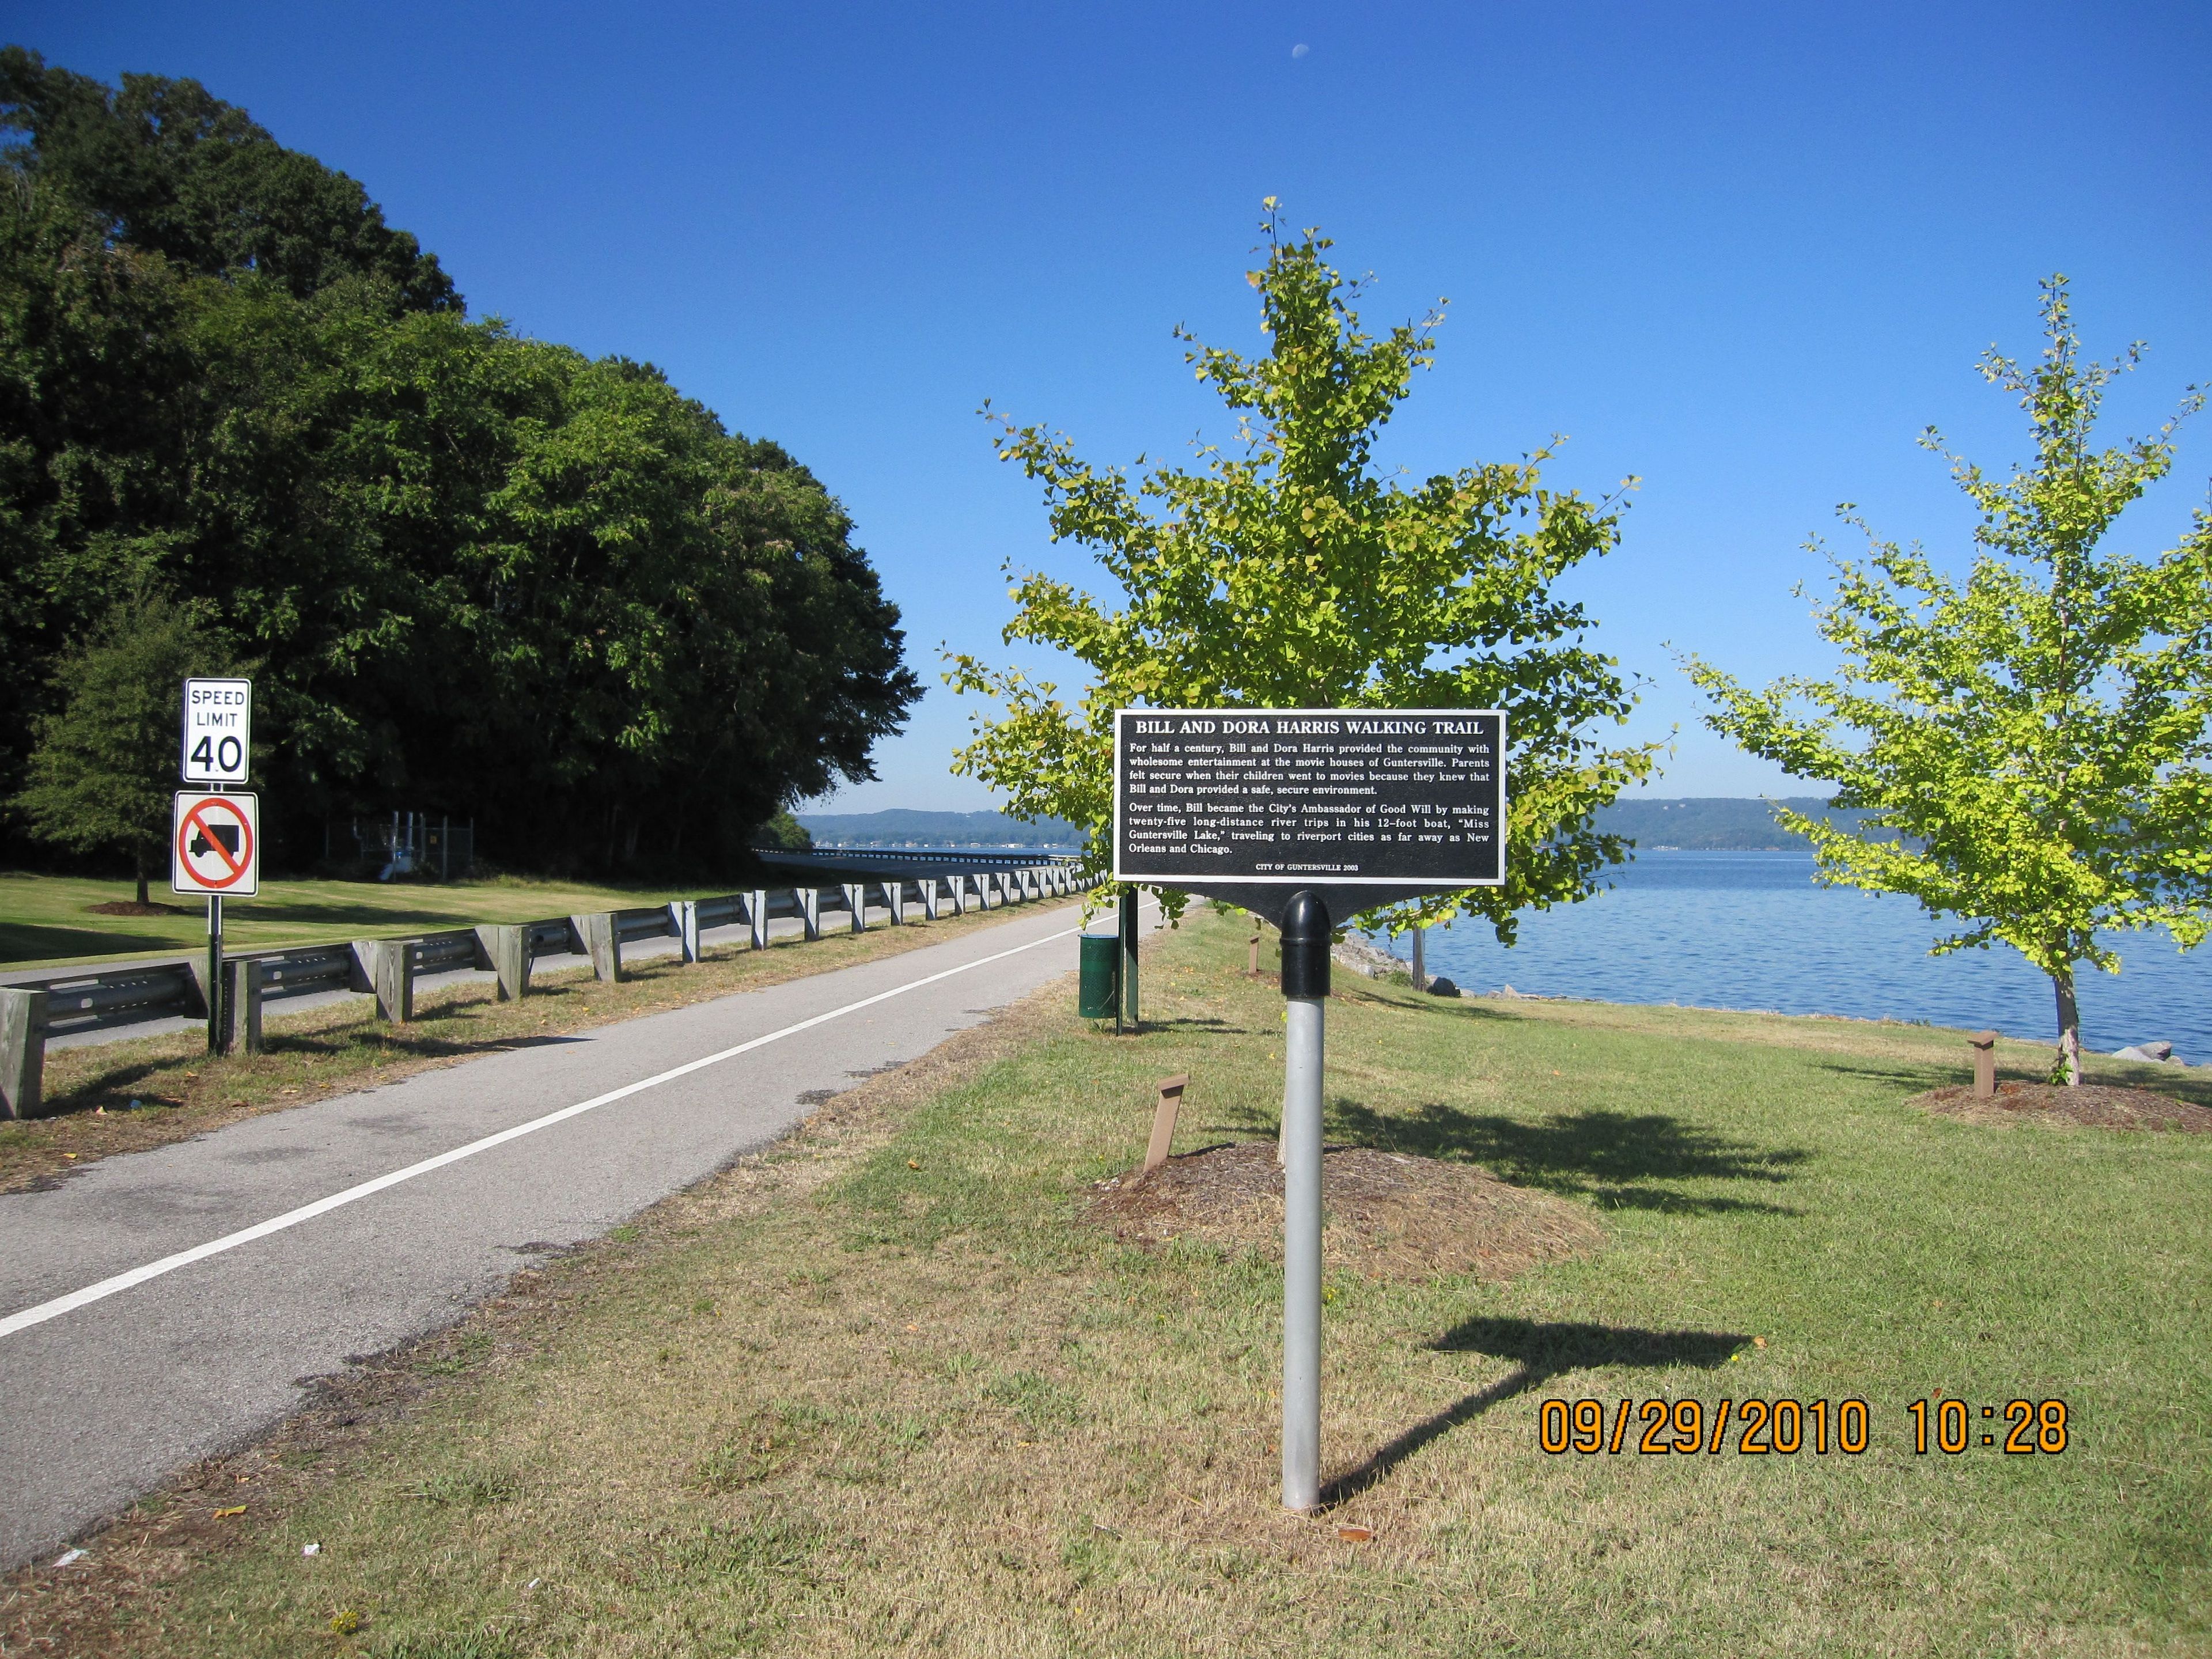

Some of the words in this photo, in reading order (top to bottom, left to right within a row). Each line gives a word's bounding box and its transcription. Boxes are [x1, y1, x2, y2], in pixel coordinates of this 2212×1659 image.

[191, 690, 244, 705] SPEED
[196, 712, 237, 727] LIMIT
[1135, 720, 1175, 734] BILL
[1179, 720, 1216, 734] AND
[1222, 721, 1271, 734] DORA
[1276, 721, 1340, 734] HARRIS
[1345, 721, 1427, 734] WALKING
[1432, 721, 1484, 734] TRAIL
[191, 736, 242, 772] 40
[1129, 743, 1147, 752] For
[1151, 743, 1171, 752] half
[1184, 744, 1225, 754] century,
[1229, 743, 1247, 752] Bill
[1251, 743, 1269, 753] and
[1273, 743, 1298, 753] Dora
[1302, 743, 1335, 752] Harris
[1339, 744, 1382, 755] provided
[1387, 744, 1403, 753] the
[1407, 744, 1464, 755] community
[1467, 744, 1490, 753] with
[1129, 756, 1183, 766] wholesome
[1187, 757, 1257, 766] entertainment
[1260, 758, 1271, 767] at
[1275, 757, 1291, 766] the
[1295, 757, 1325, 766] movie
[1329, 757, 1364, 766] houses
[1369, 757, 1380, 767] of
[1383, 757, 1446, 767] Guntersville.
[1451, 758, 1490, 767] Parents
[1129, 770, 1146, 780] felt
[1185, 770, 1211, 780] when
[1215, 770, 1240, 780] their
[1243, 771, 1284, 780] children
[1287, 772, 1312, 780] went
[1316, 772, 1326, 780] to
[1330, 771, 1365, 781] movies
[1369, 771, 1409, 781] because
[1413, 771, 1435, 783] they
[1439, 771, 1466, 781] knew
[1469, 772, 1490, 781] that
[1129, 783, 1146, 793] Bill
[1149, 783, 1167, 794] and
[1169, 784, 1194, 794] Dora
[1196, 784, 1240, 795] provided
[1251, 785, 1274, 796] safe,
[1312, 785, 1377, 794] environment.
[1129, 802, 1153, 812] Over
[1157, 802, 1181, 813] time,
[1185, 802, 1203, 812] Bill
[1207, 802, 1244, 812] became
[1248, 803, 1264, 813] the
[1300, 804, 1362, 813] Ambassador
[1365, 804, 1376, 813] of
[1380, 804, 1406, 813] Good
[1410, 804, 1431, 813] Will
[1435, 804, 1448, 816] by
[1452, 805, 1490, 816] making
[1128, 816, 1186, 827] twenty-five
[1193, 816, 1264, 828] long-distance
[1271, 817, 1297, 827] river
[1304, 817, 1329, 828] trips
[1336, 817, 1346, 827] in
[1354, 818, 1370, 827] his
[1423, 818, 1451, 829] boat,
[1128, 830, 1188, 839] Guntersville
[1231, 831, 1275, 842] traveling
[1281, 832, 1291, 840] to
[1297, 831, 1342, 842] riverport
[1347, 832, 1374, 841] cities
[1397, 832, 1412, 841] far
[1418, 835, 1444, 843] away
[1467, 833, 1490, 842] New
[1128, 843, 1166, 853] Orleans
[1169, 843, 1187, 853] and
[1190, 843, 1233, 855] Chicago.
